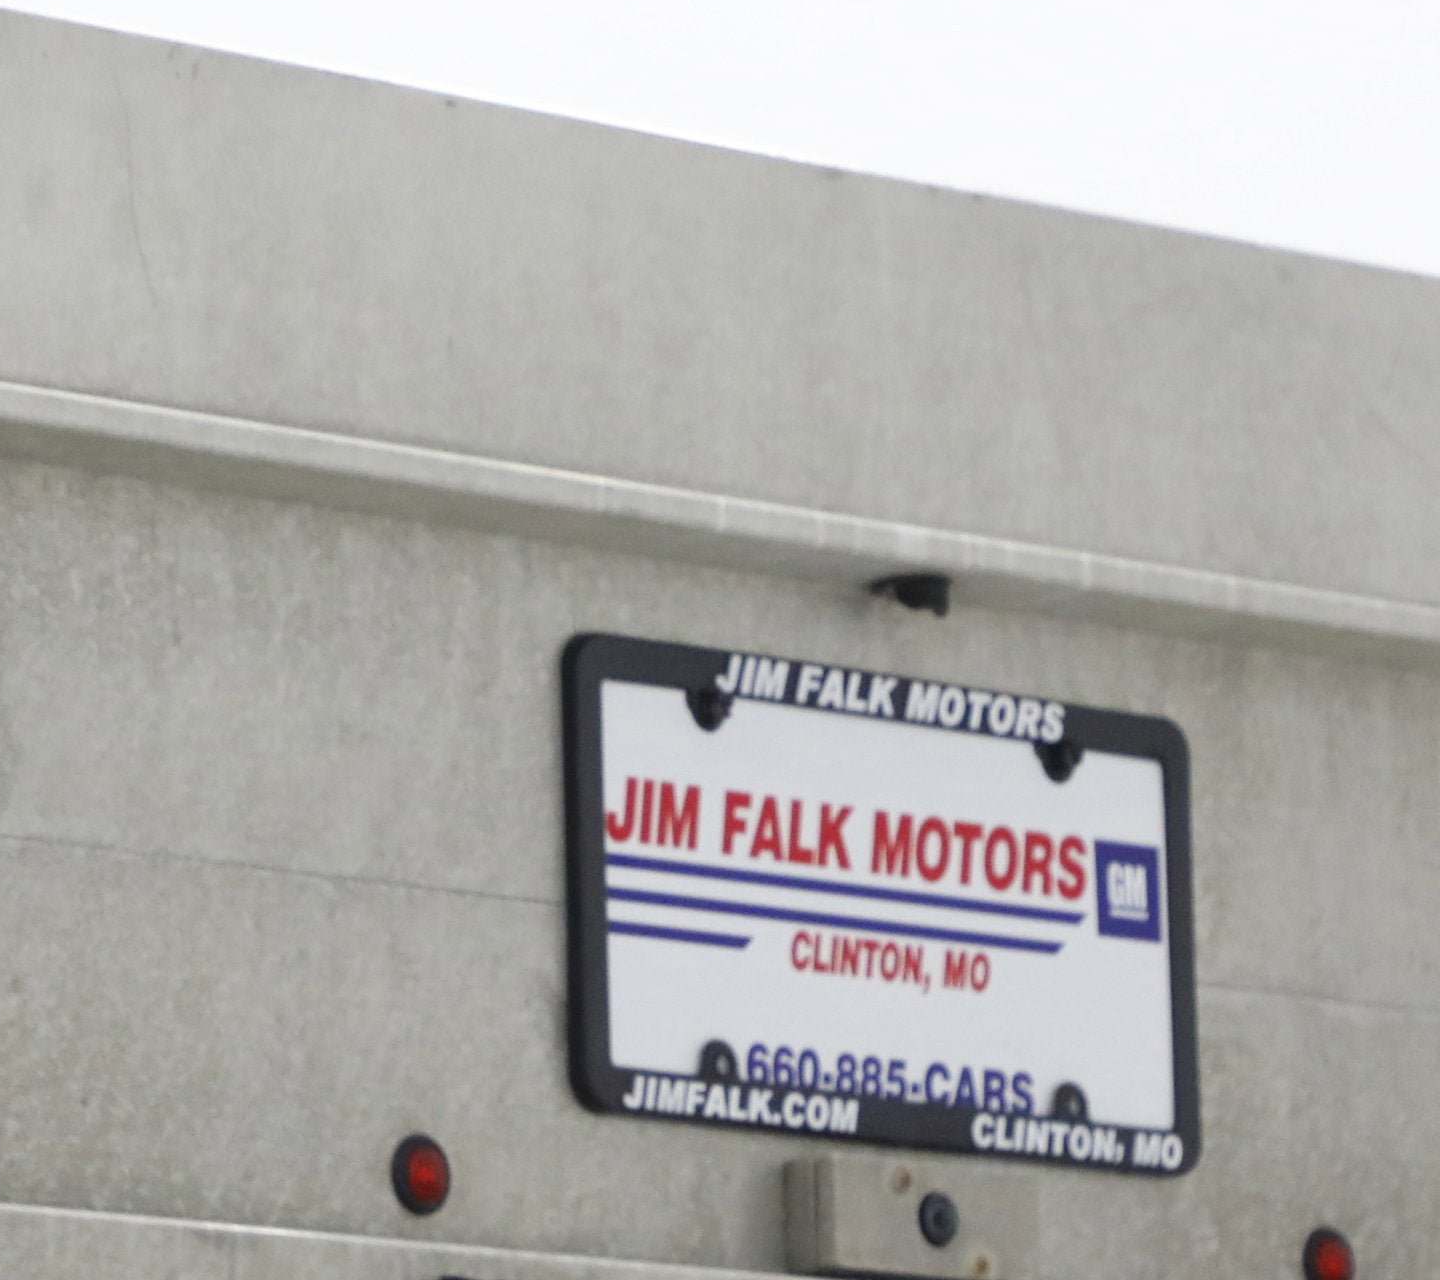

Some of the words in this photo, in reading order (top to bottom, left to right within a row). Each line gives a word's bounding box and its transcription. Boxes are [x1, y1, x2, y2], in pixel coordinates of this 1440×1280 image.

[715, 653, 787, 699] JIM
[796, 664, 897, 718] FALK
[905, 682, 1066, 743] MOTORS
[604, 777, 701, 850] JIM
[721, 790, 854, 872] FALK
[871, 811, 1088, 902] MOTORS
[1105, 860, 1148, 910] GM
[790, 930, 931, 994] CLINTON,
[943, 950, 991, 993] MO
[622, 1074, 859, 1134] JIMFALK.COM
[746, 1043, 1035, 1116] 660-885-CARS
[971, 1112, 1124, 1164] CLINTON,
[1133, 1125, 1183, 1170] MO
